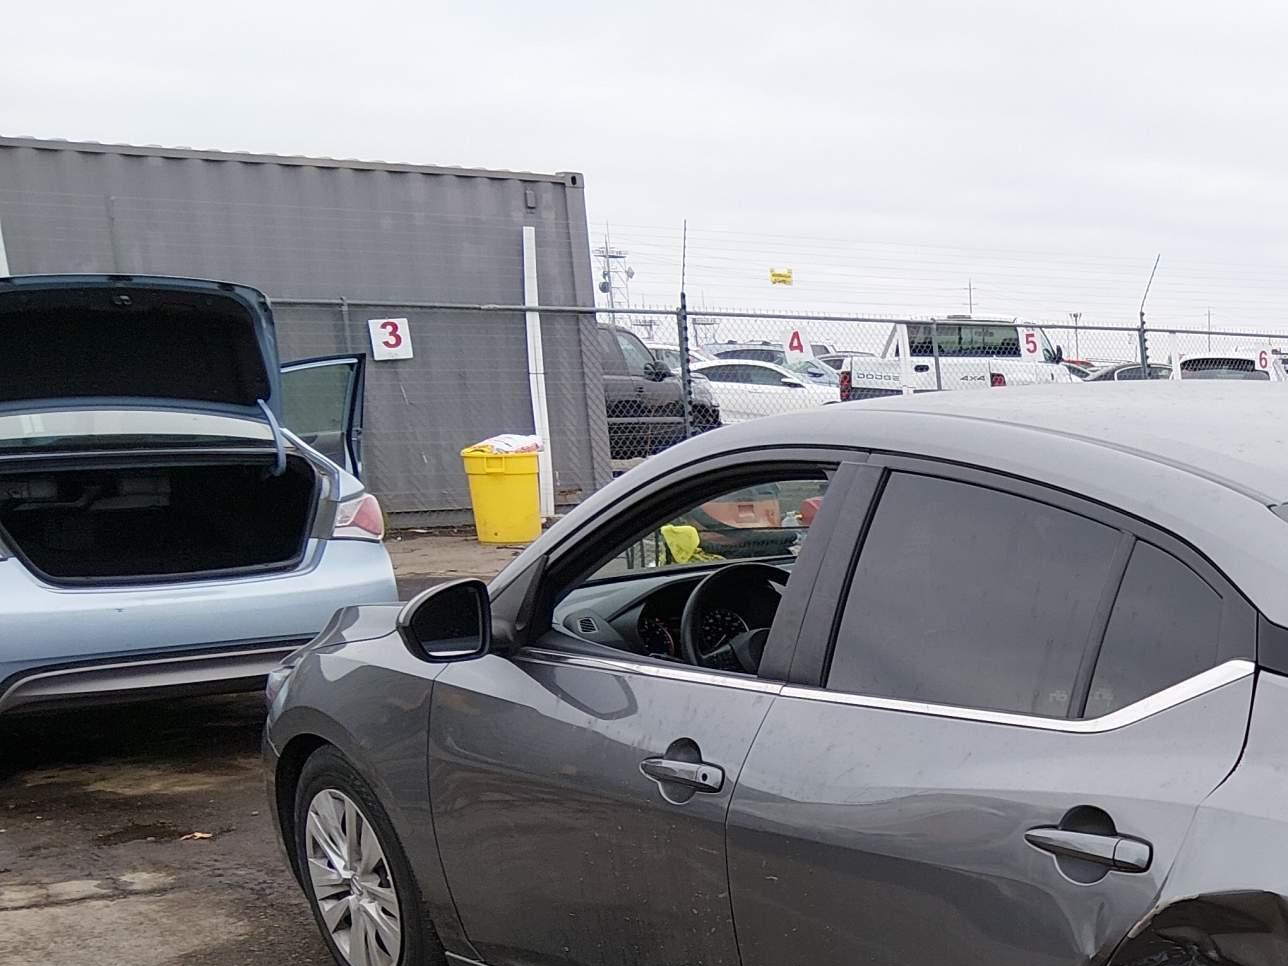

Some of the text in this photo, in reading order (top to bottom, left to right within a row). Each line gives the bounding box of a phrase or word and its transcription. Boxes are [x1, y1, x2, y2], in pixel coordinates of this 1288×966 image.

[380, 321, 402, 349] 3
[788, 331, 804, 354] 4
[1025, 333, 1038, 354] 5
[1259, 350, 1268, 369] 6
[857, 373, 900, 382] DODGE
